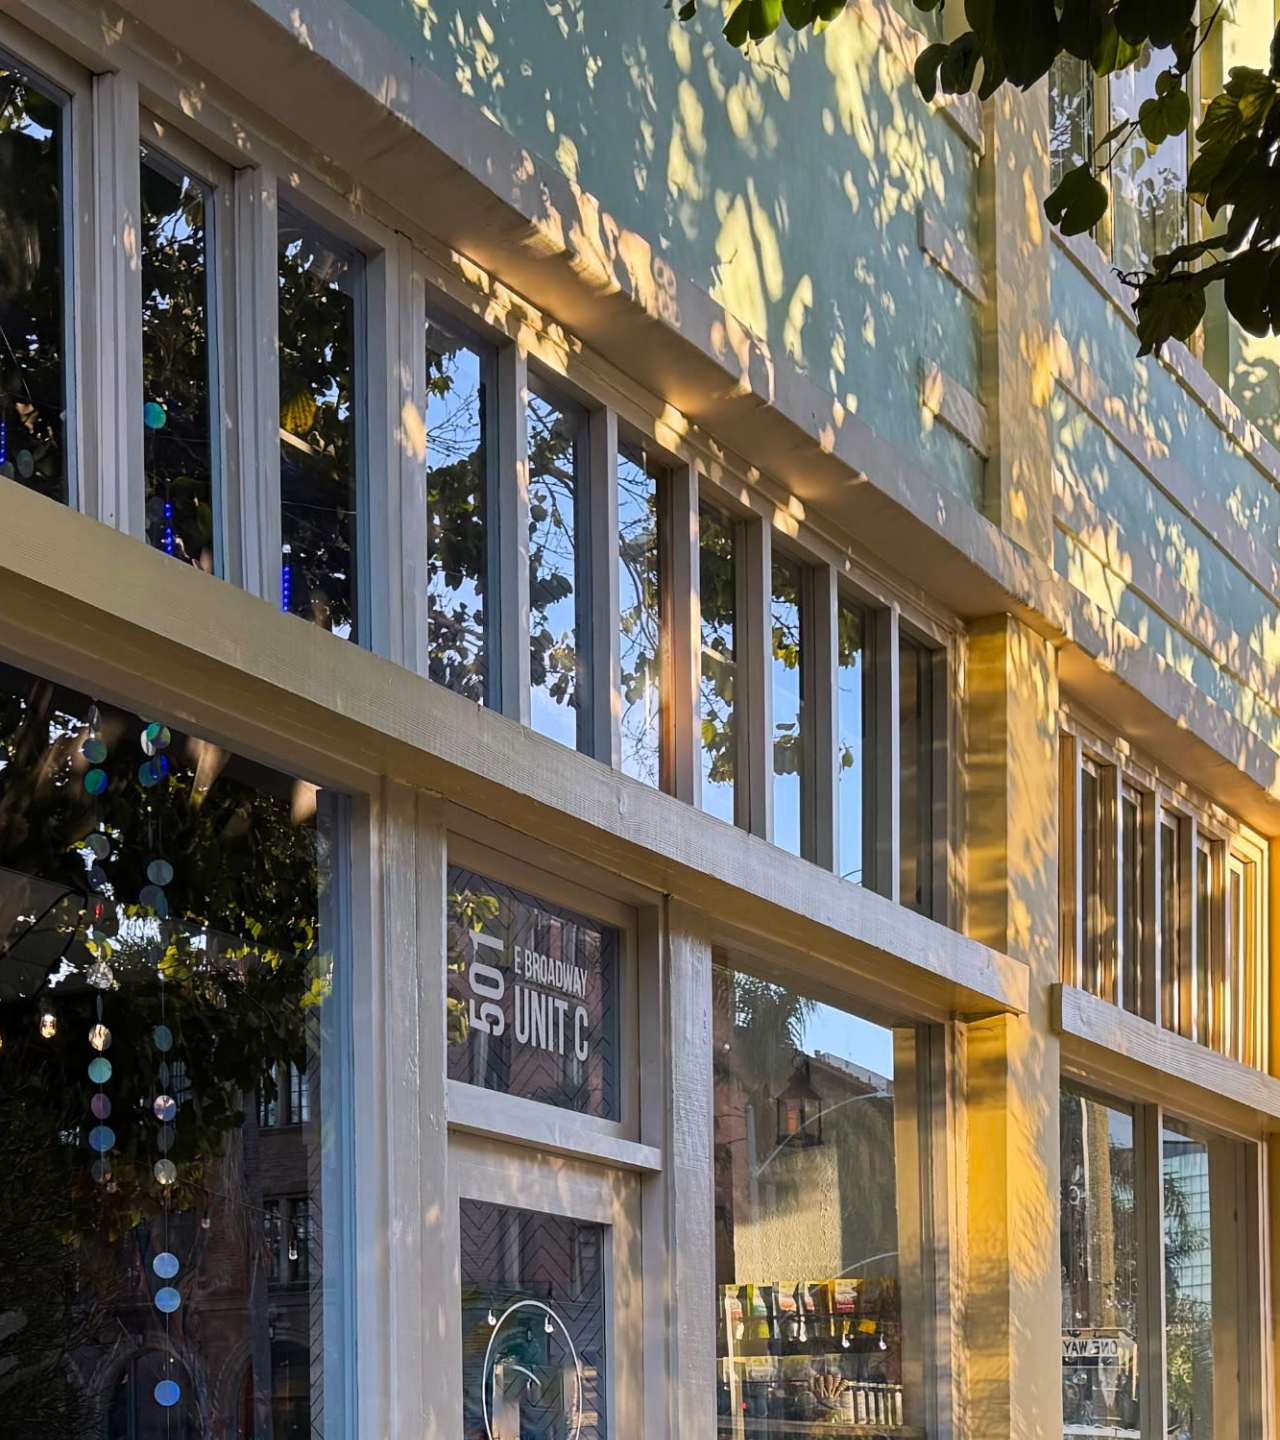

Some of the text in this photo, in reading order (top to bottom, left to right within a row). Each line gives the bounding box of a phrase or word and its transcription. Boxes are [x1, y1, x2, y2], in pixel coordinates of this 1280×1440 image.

[470, 929, 504, 1037] 501
[514, 945, 588, 1000] E BROADWAY
[514, 985, 588, 1062] UNIT C
